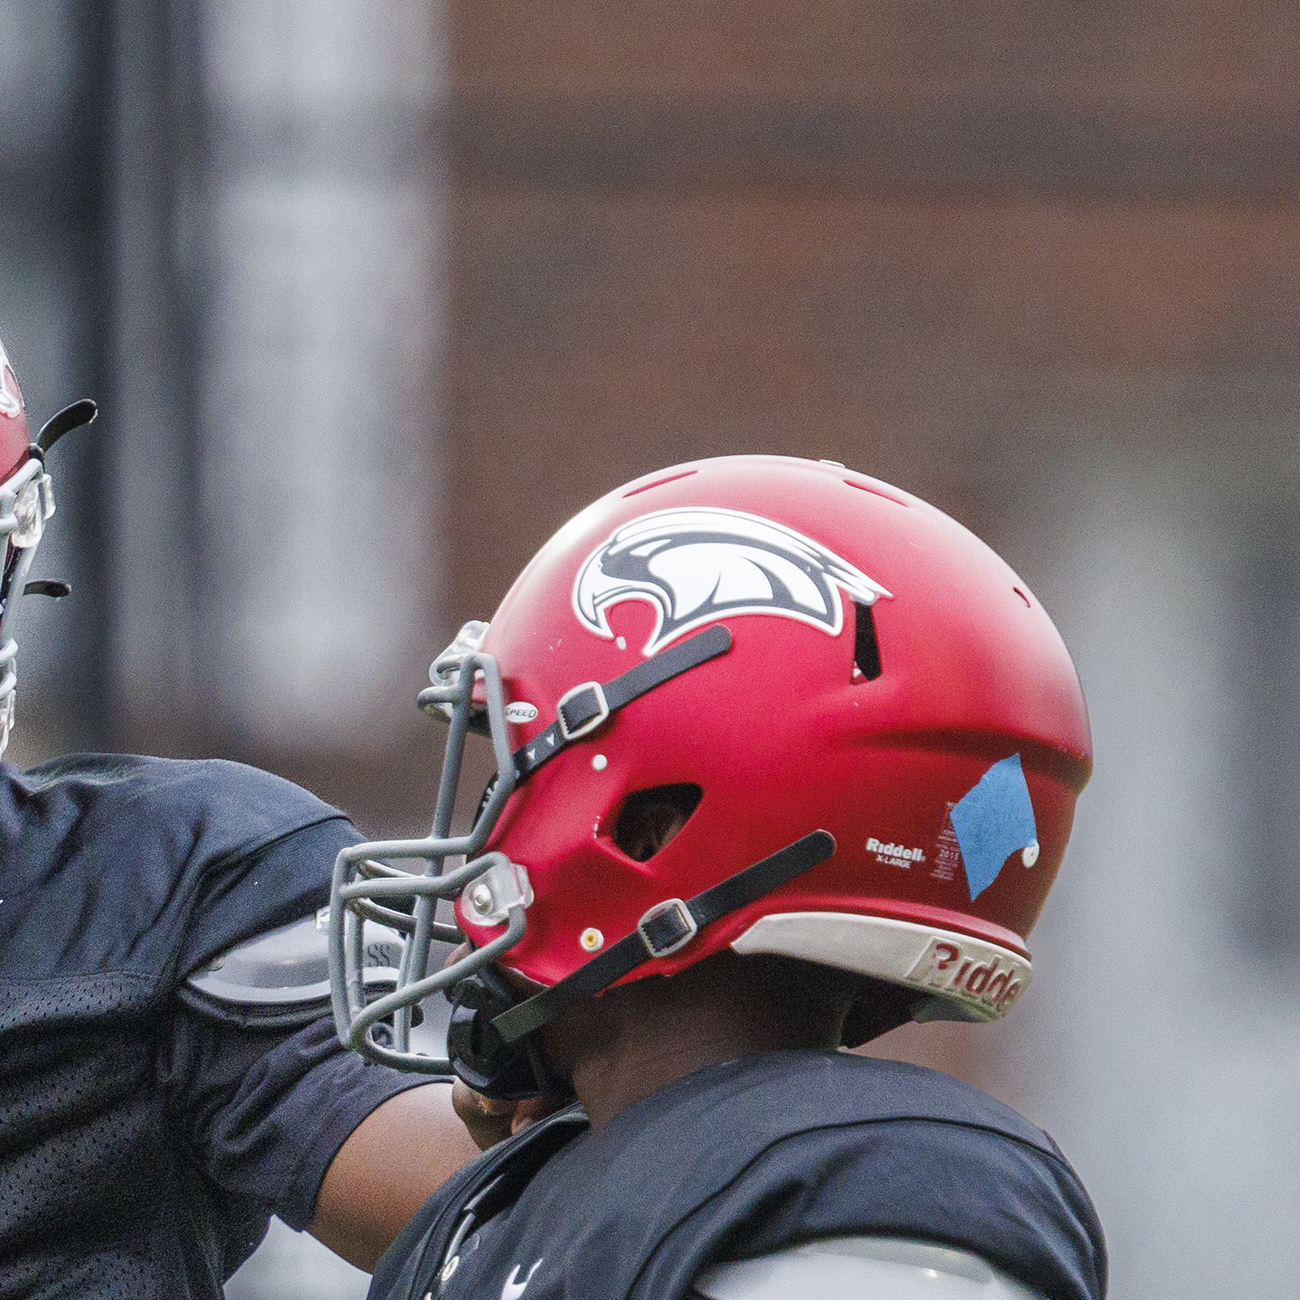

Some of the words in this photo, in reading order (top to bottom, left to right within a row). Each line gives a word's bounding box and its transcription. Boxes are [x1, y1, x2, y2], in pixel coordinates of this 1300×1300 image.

[503, 707, 537, 719] SPEED
[866, 837, 923, 862] Riddell
[876, 854, 912, 869] X-LARGE
